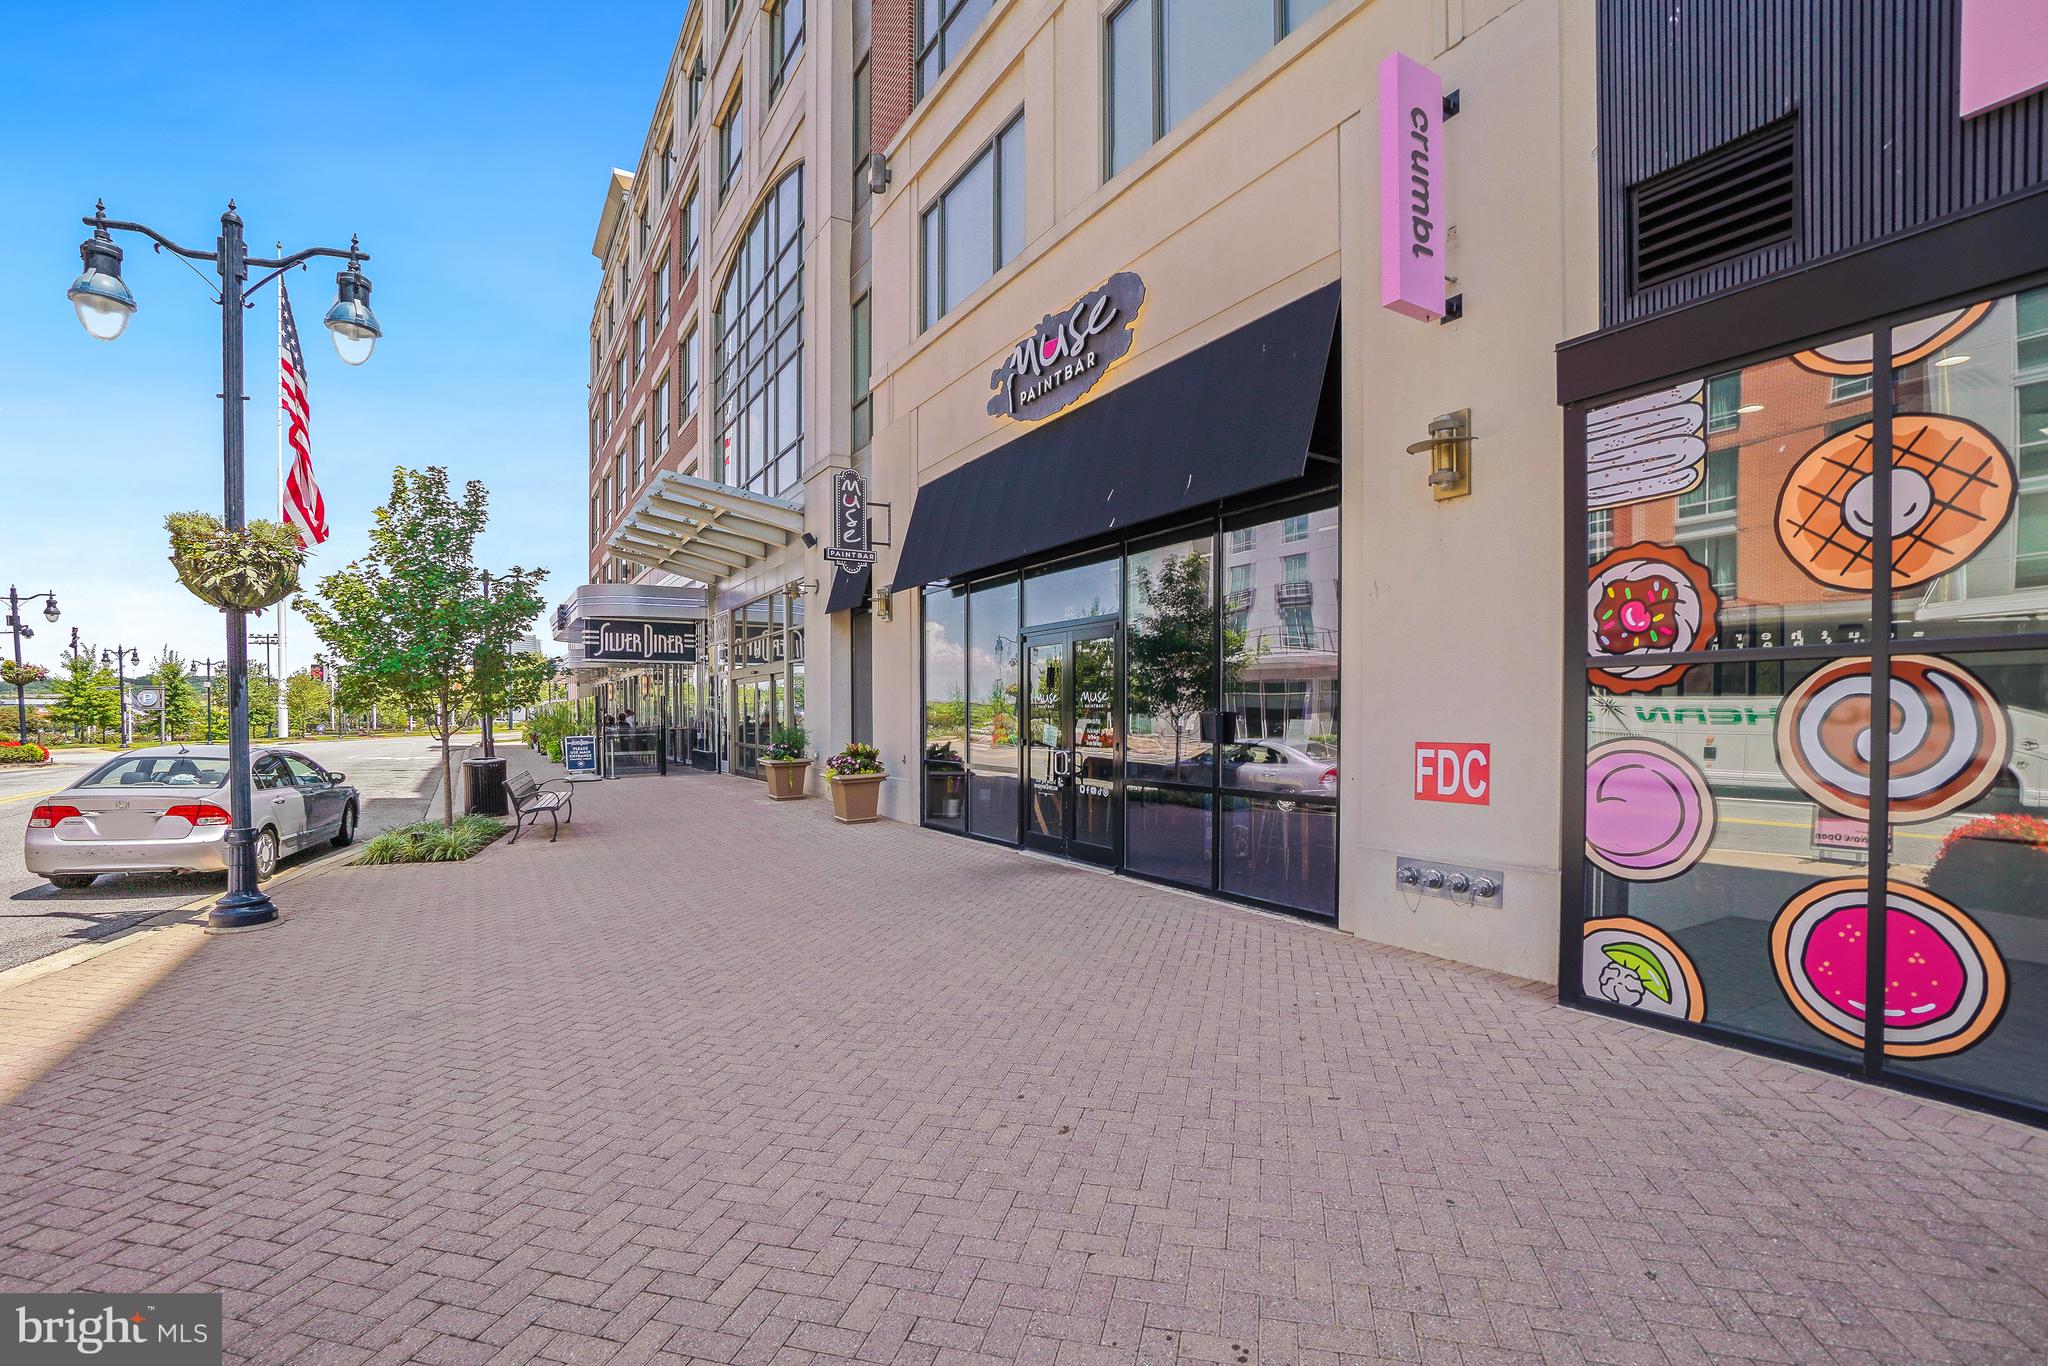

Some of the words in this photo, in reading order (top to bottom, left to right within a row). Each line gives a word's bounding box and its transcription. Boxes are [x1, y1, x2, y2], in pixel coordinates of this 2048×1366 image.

[1411, 107, 1434, 258] crumbl
[1020, 351, 1095, 405] PAINTBAR
[830, 550, 875, 560] PAINTBAR
[1416, 749, 1488, 798] FDC
